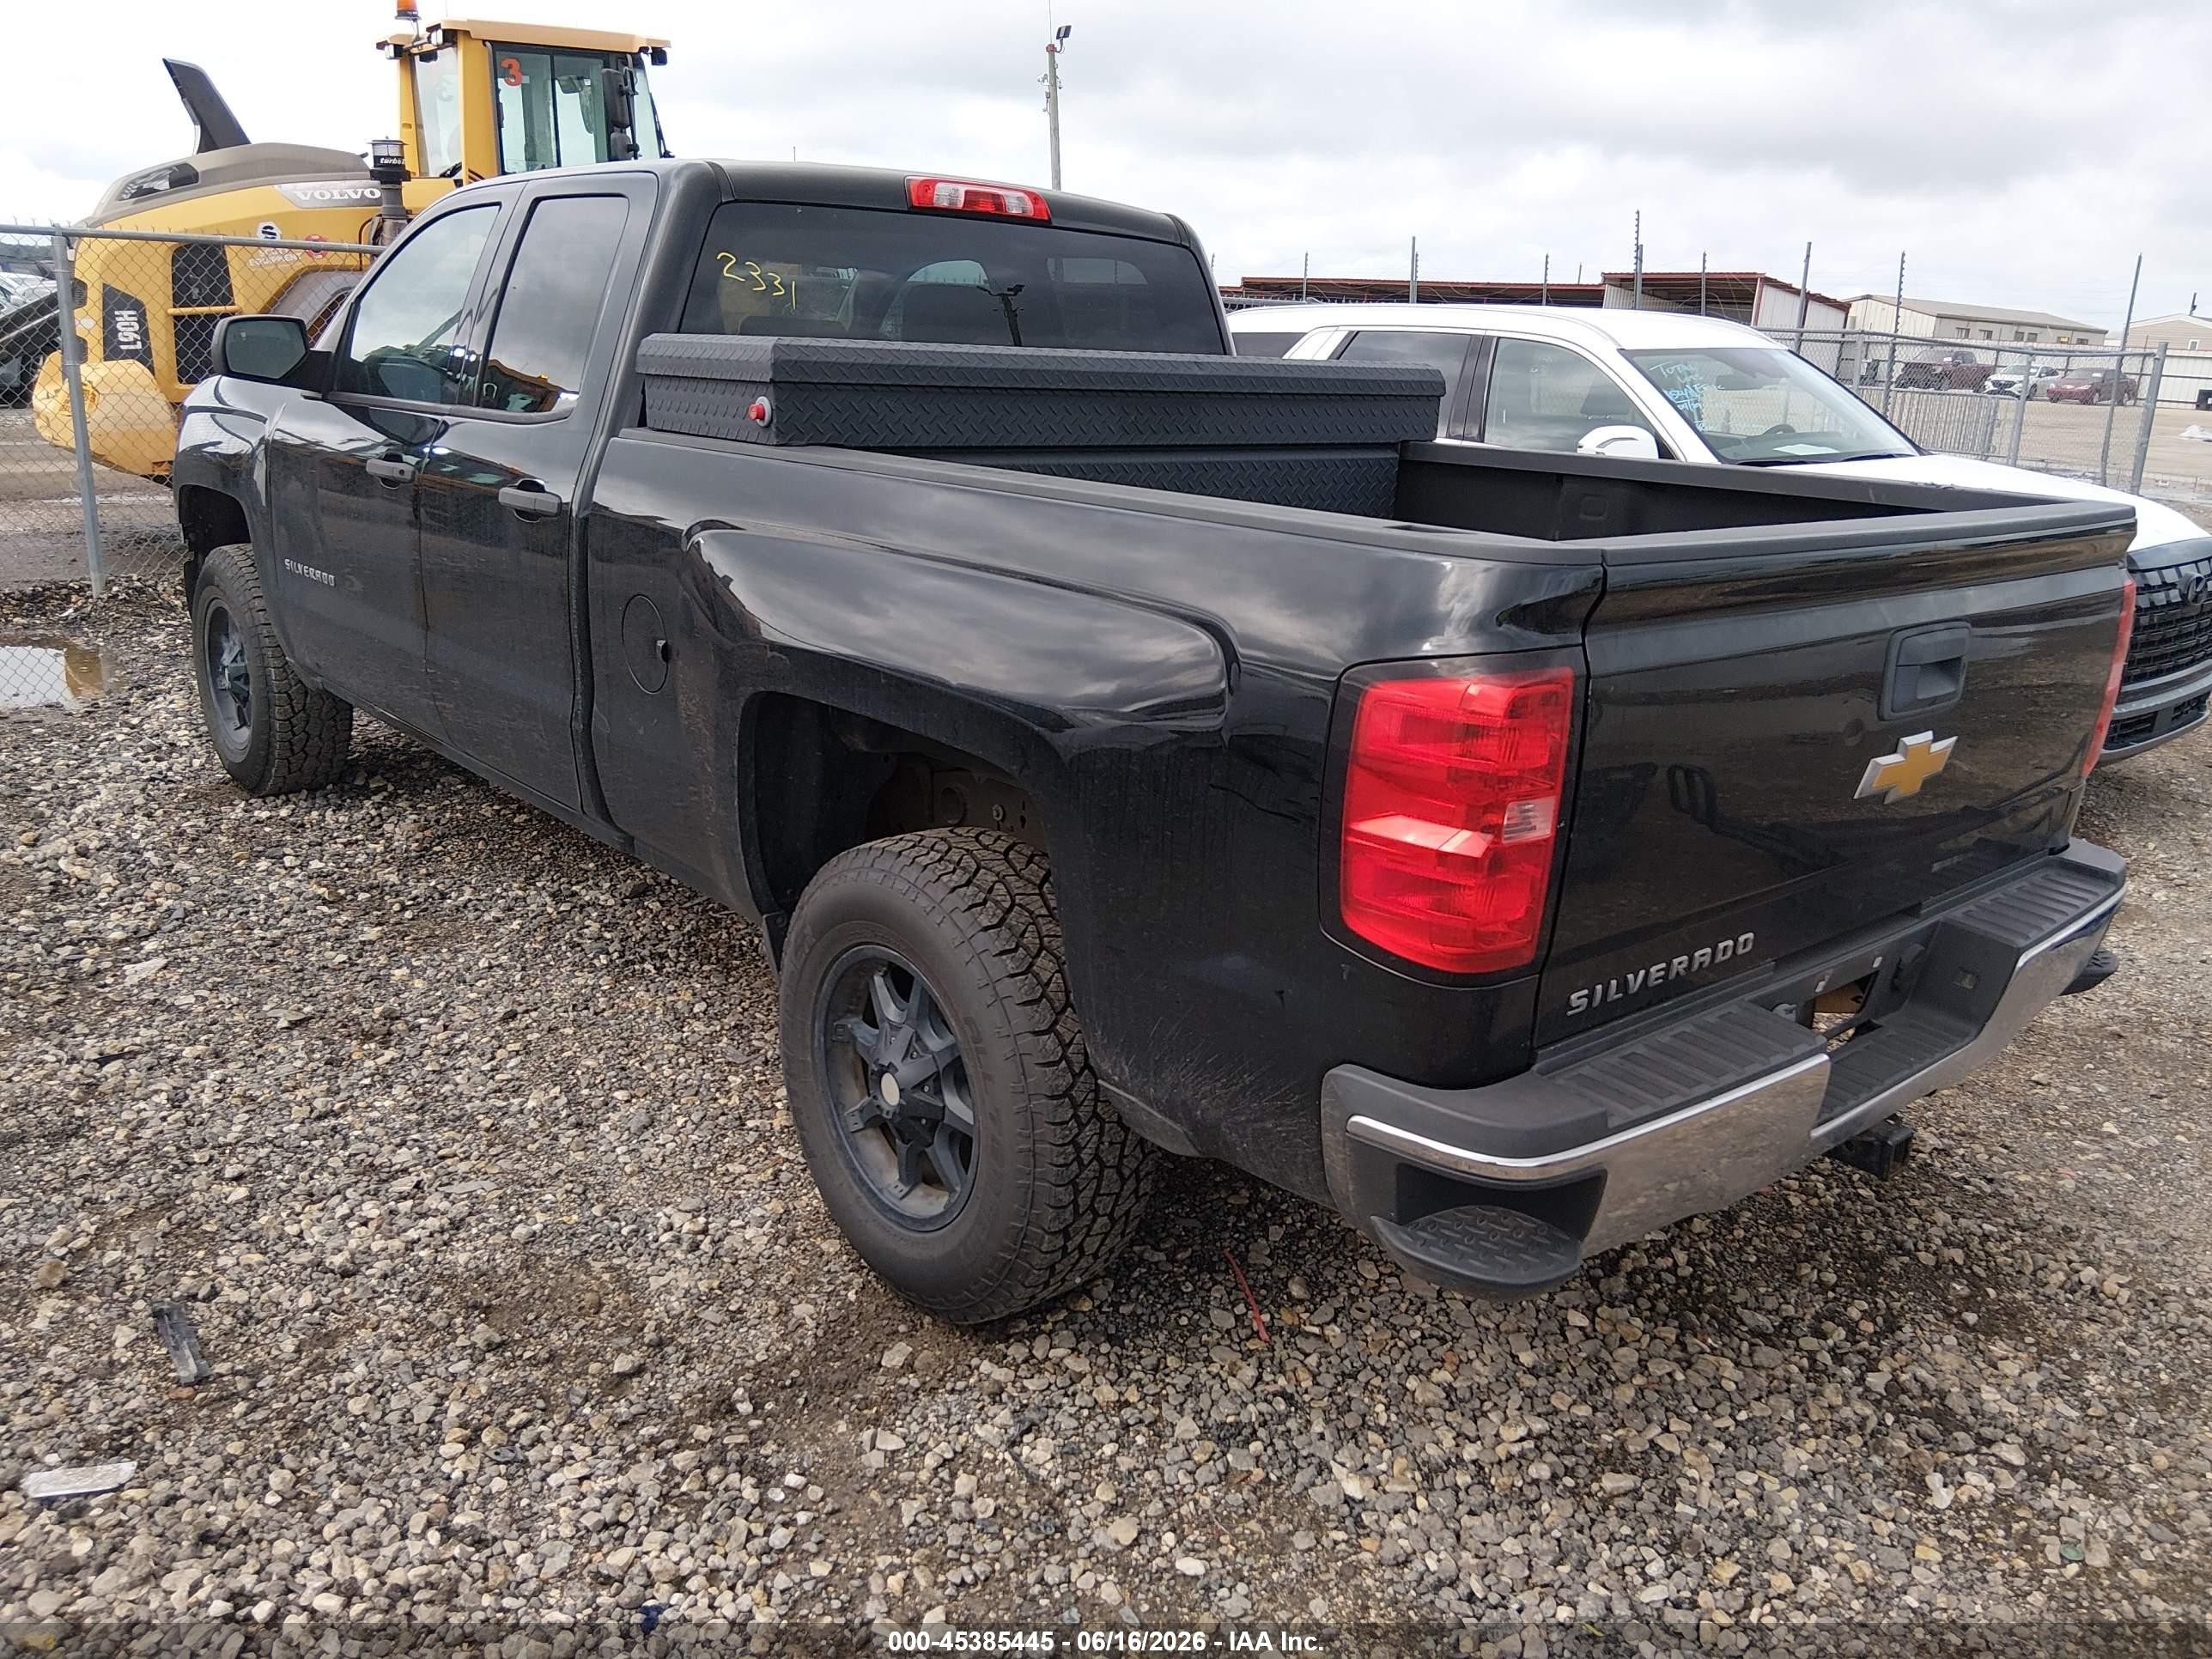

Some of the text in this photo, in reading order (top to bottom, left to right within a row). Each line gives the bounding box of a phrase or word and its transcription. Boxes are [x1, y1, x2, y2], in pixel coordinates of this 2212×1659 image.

[501, 57, 523, 87] 3
[294, 187, 381, 201] VOLVO
[716, 252, 796, 310] 2331
[113, 310, 143, 349] L90H
[284, 558, 336, 586] SILVERADO
[1565, 932, 1755, 1017] SILVERADO
